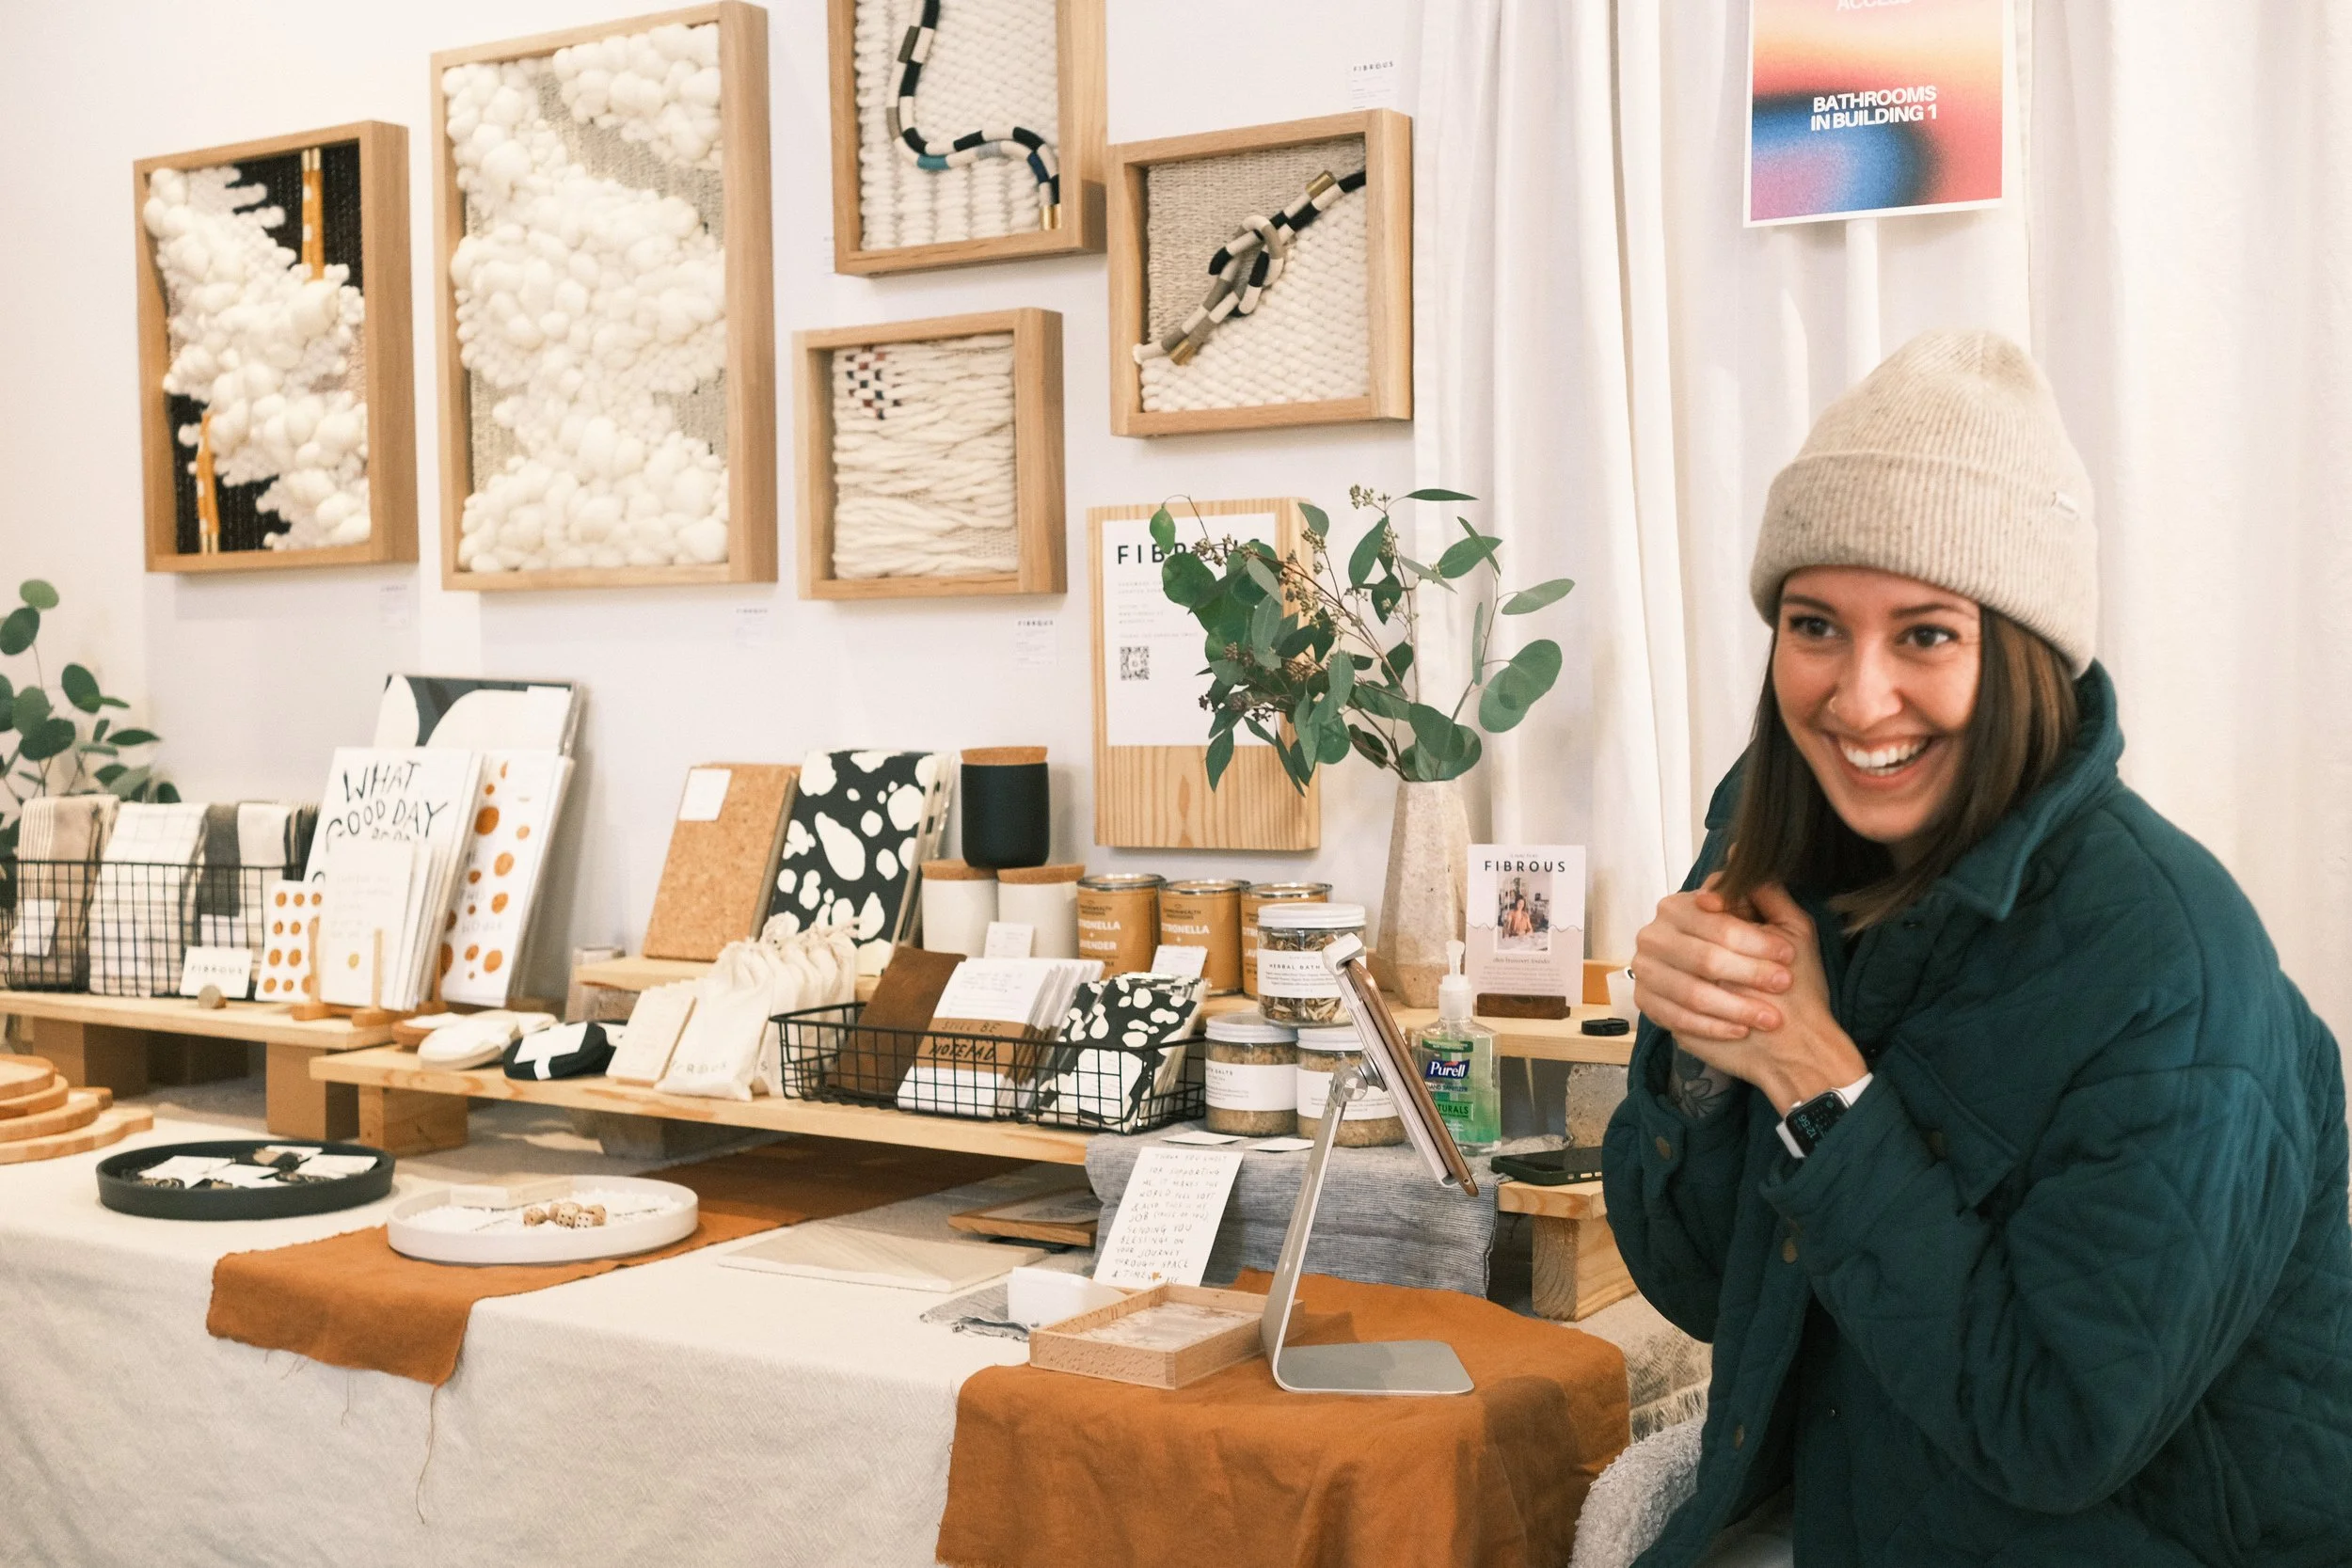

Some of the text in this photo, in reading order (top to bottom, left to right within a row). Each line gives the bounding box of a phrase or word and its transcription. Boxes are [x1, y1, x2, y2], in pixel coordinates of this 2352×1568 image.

[1813, 85, 1937, 113] BATHROOMS
[1810, 104, 1938, 132] IN BUILDING 1
[342, 759, 422, 803] WHAT
[325, 798, 449, 854] GOOD DAY
[1485, 860, 1566, 874] FIBROUS
[980, 1021, 1001, 1033] BE
[1430, 1061, 1466, 1078] Purell
[1438, 1103, 1470, 1115] TURALS
